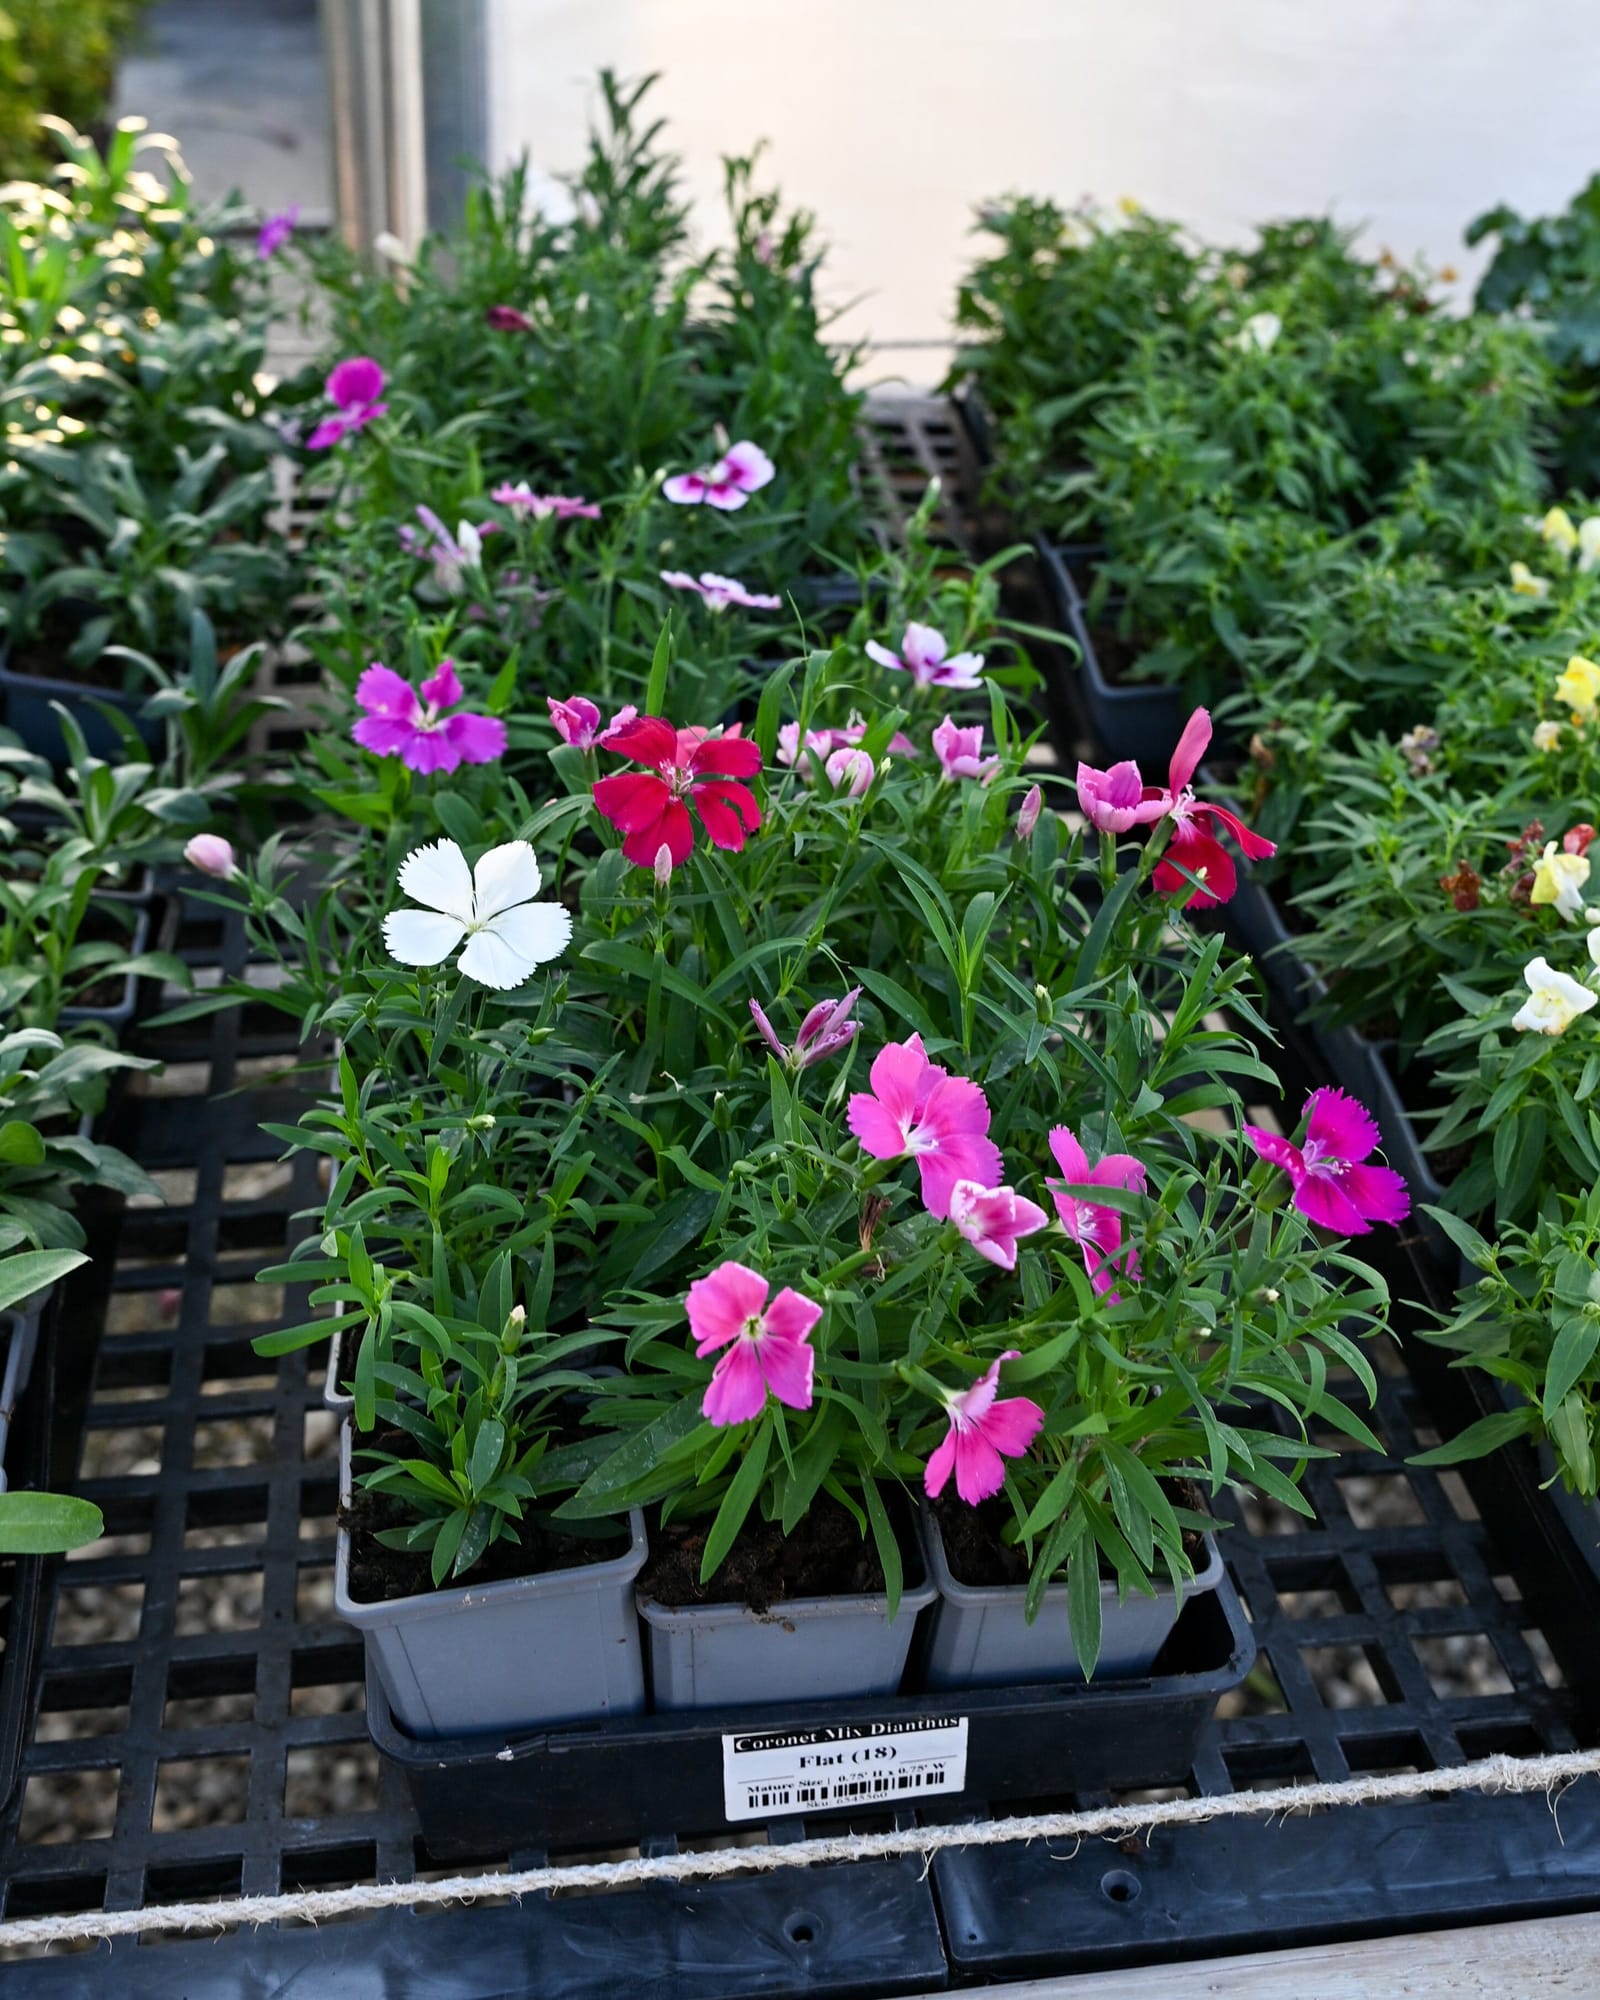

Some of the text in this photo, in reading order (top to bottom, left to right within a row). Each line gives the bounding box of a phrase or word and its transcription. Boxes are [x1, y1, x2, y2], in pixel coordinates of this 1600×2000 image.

[735, 1717, 958, 1752] Coronet Mix Dianthus
[800, 1746, 897, 1768] Flat (18)
[747, 1782, 795, 1793] Mature
[799, 1777, 824, 1788] Size
[873, 1769, 883, 1777] H
[933, 1762, 946, 1770] W
